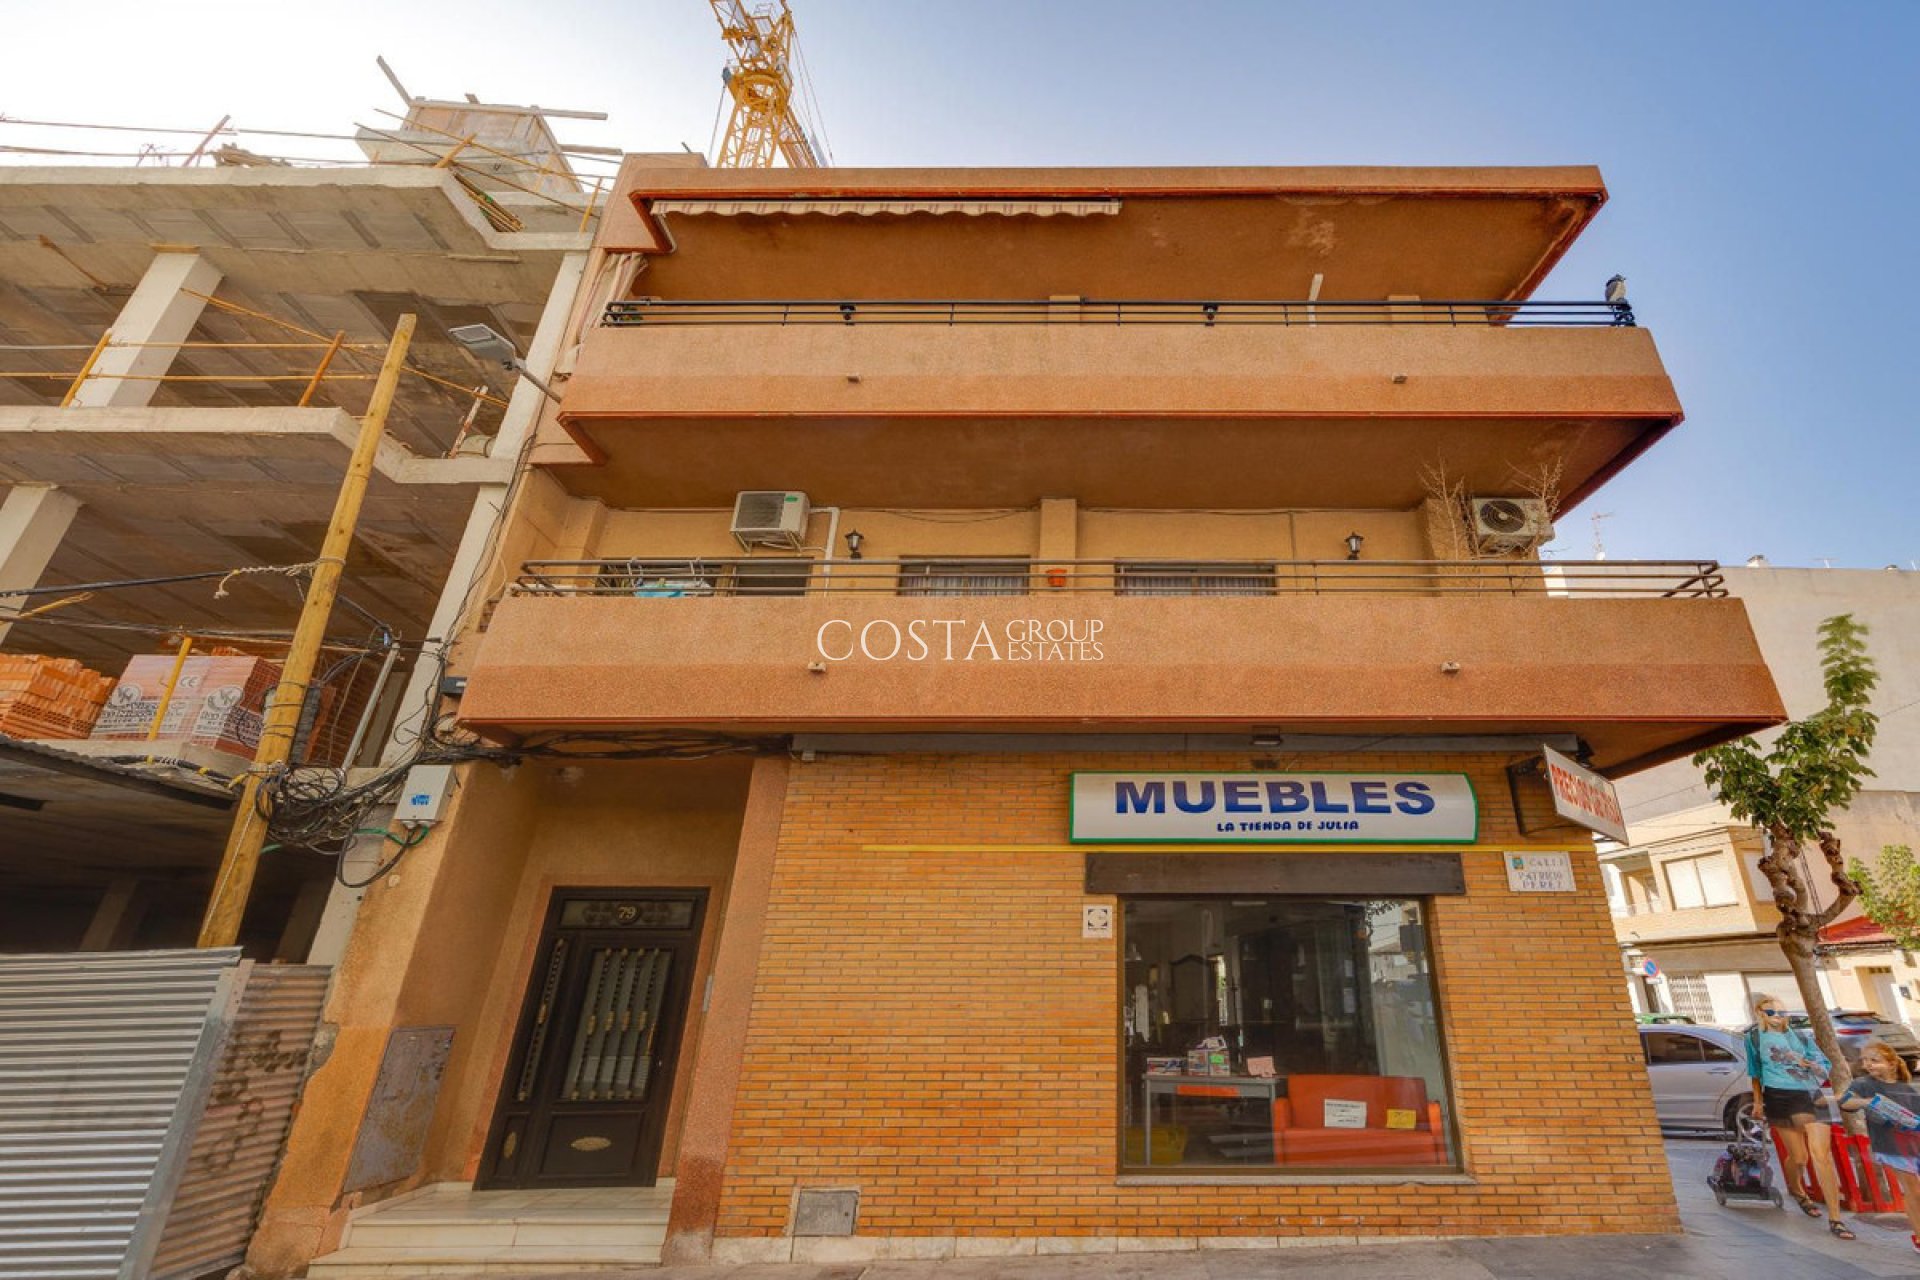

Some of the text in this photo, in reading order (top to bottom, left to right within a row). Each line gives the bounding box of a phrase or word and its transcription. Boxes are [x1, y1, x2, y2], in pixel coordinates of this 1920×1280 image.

[1114, 781, 1435, 815] MUEBLES
[1217, 820, 1359, 832] LA TIENDA DE JULIA
[618, 905, 637, 919] 79
